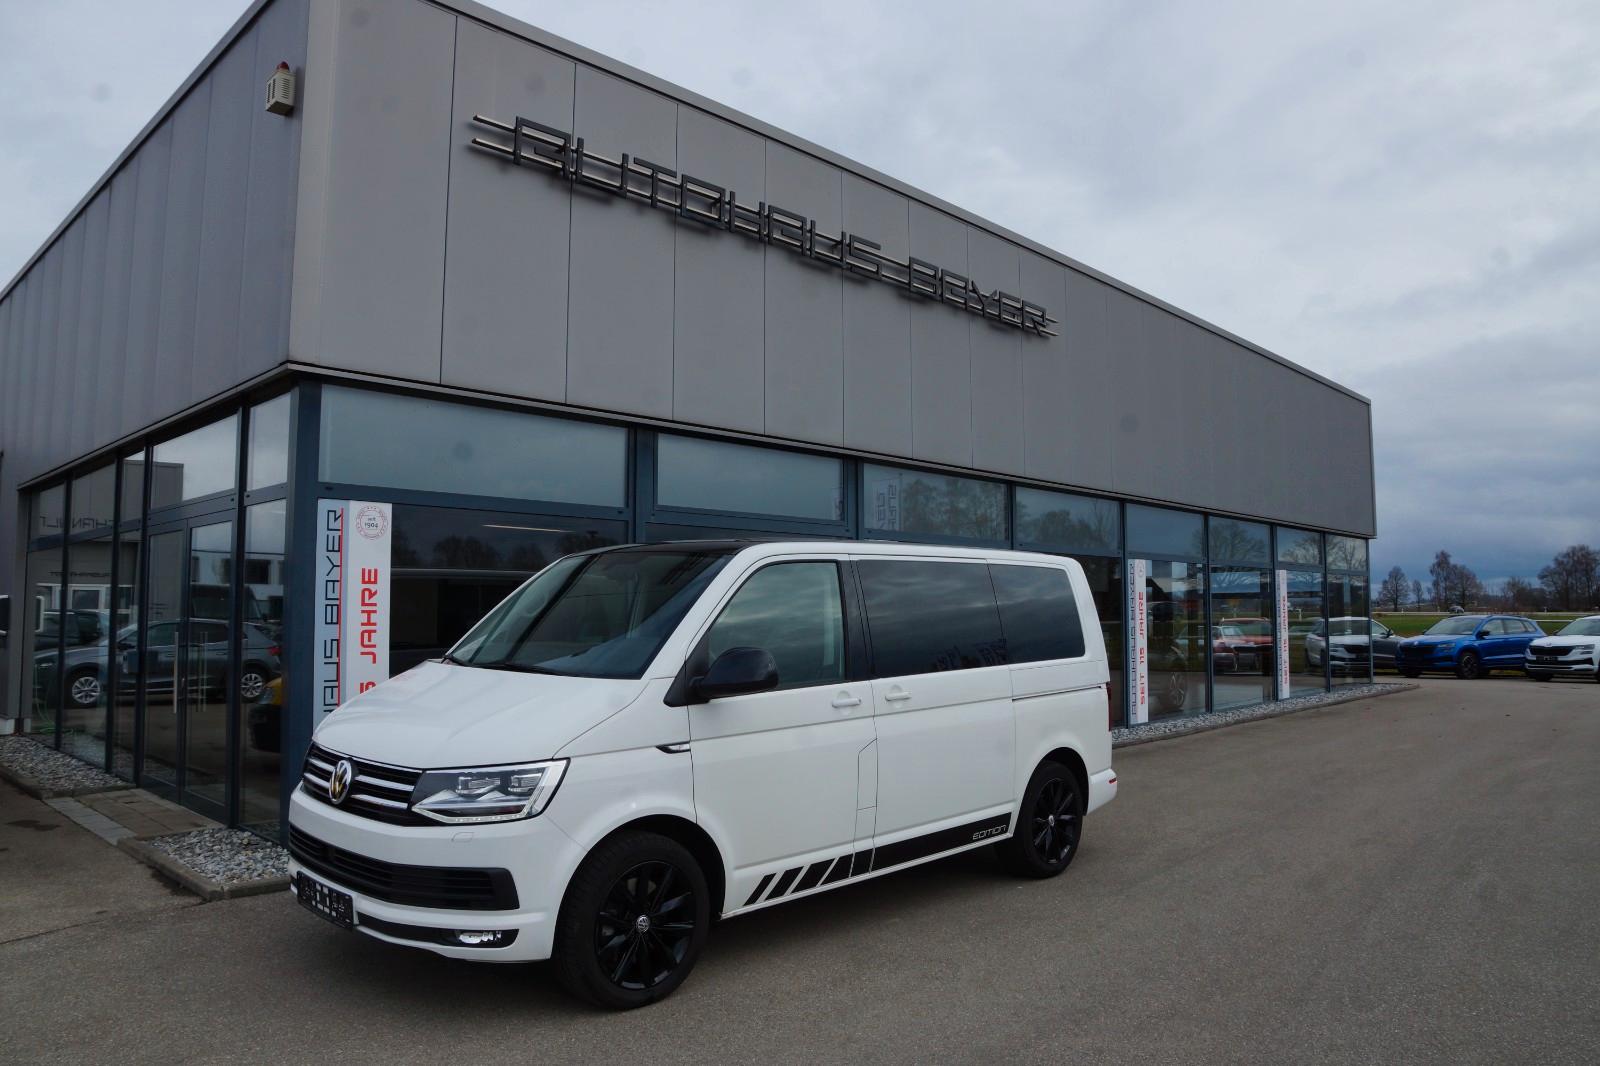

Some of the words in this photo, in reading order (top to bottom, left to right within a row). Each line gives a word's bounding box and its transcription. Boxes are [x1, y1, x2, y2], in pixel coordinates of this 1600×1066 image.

[514, 115, 883, 282] AUTOHAUS
[909, 256, 1047, 336] BAYER
[325, 509, 342, 625] BAYER
[360, 567, 378, 664] JAHRE
